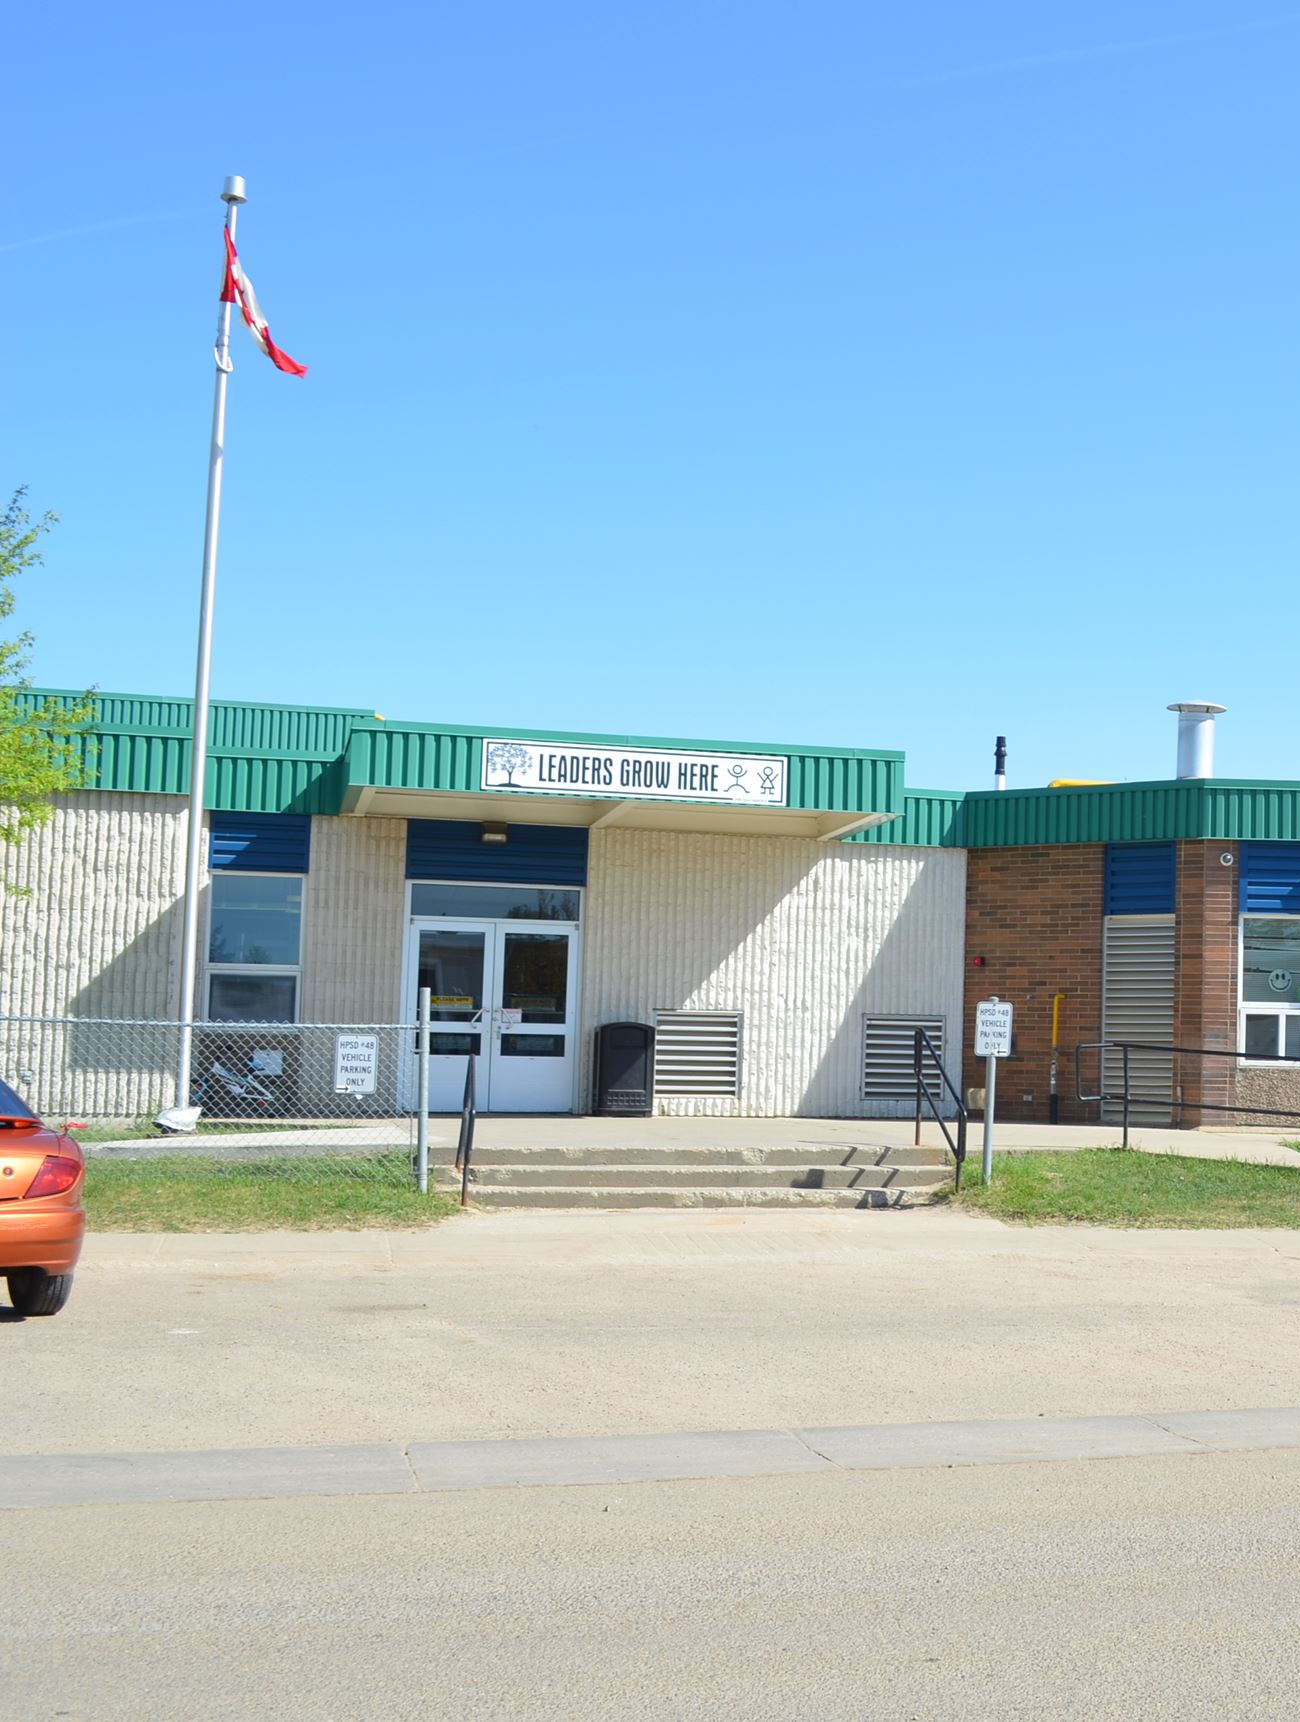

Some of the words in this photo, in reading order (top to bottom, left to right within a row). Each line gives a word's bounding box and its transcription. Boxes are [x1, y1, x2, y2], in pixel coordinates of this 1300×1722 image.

[538, 753, 613, 786] LEADERS
[620, 758, 671, 789] GROW
[678, 762, 719, 792] HERE
[981, 1020, 1007, 1028] VEHICLE
[340, 1041, 359, 1049] HPSD
[984, 1042, 1001, 1050] OLY
[341, 1053, 372, 1062] VEHICLE
[340, 1065, 372, 1074] PARKING
[345, 1078, 365, 1086] ONLY
